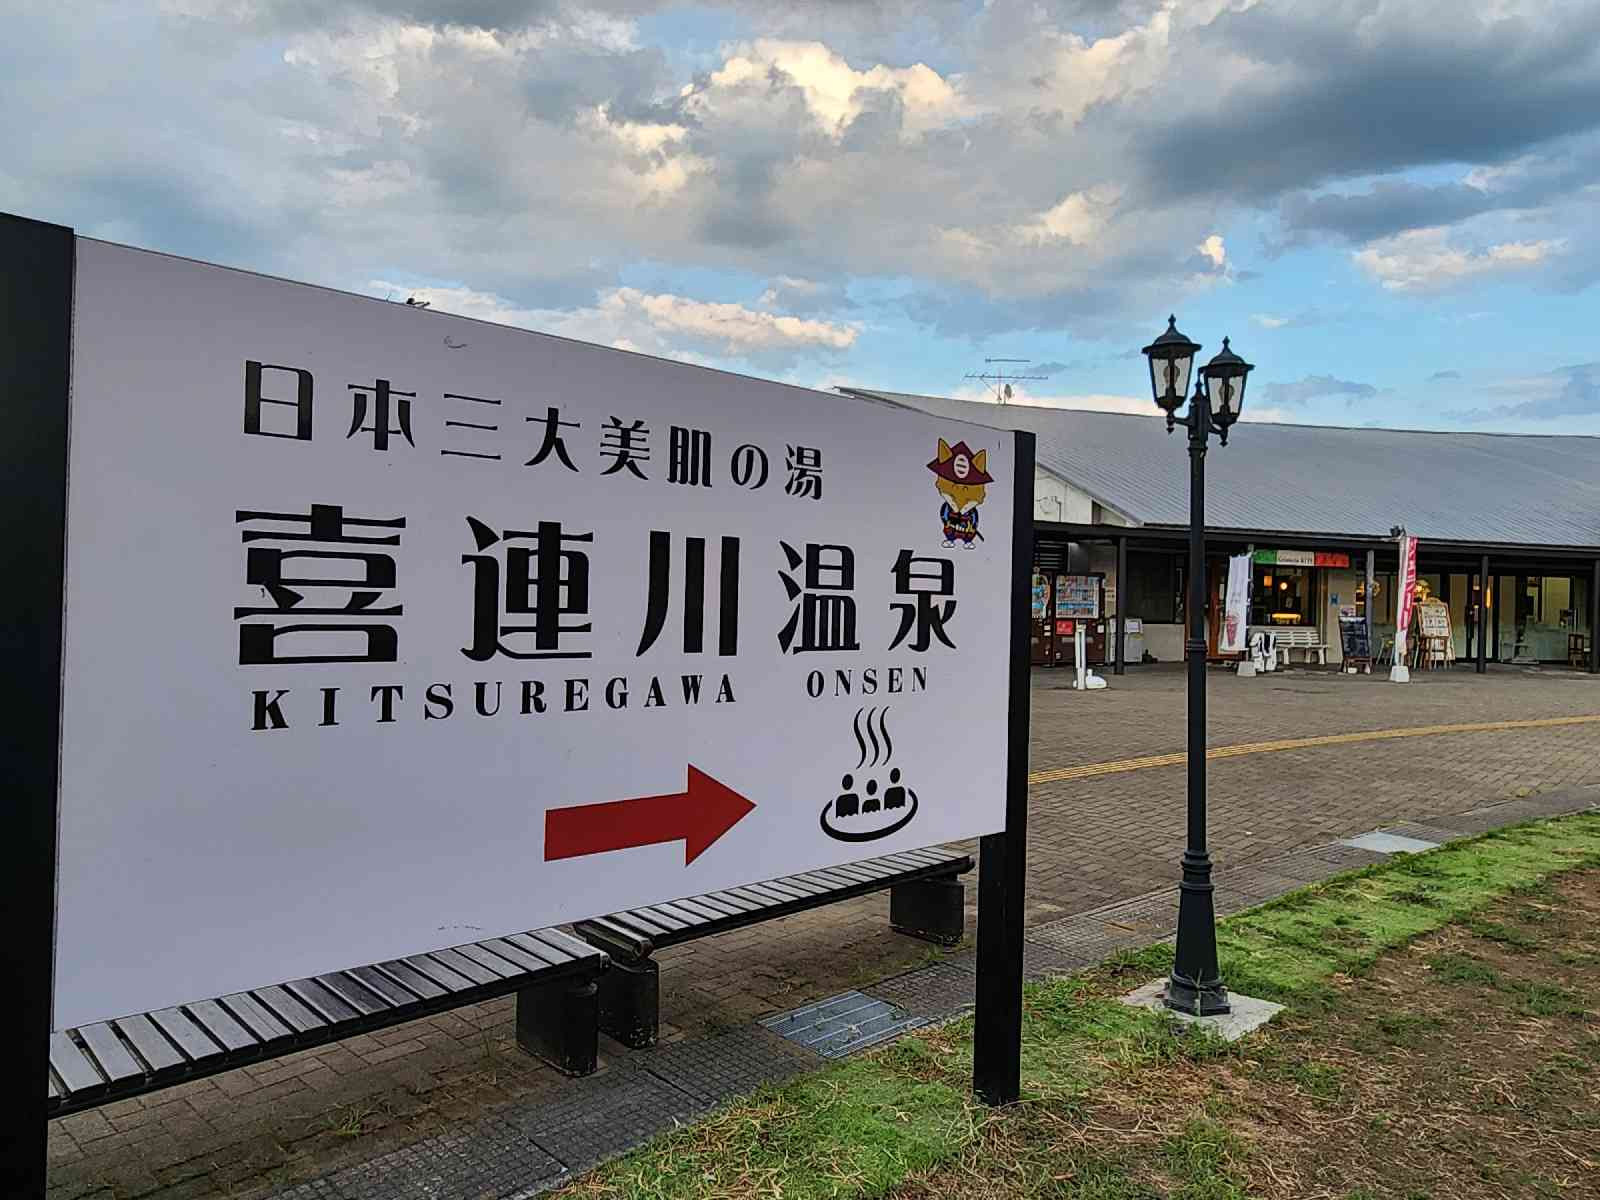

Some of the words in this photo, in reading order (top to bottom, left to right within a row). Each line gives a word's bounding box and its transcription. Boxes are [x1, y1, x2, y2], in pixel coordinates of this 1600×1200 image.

[244, 360, 823, 500] 日本三大美肌の湯
[234, 504, 958, 665] 喜連川温泉
[252, 673, 735, 730] KITSUREGAWA
[807, 667, 928, 698] ONSEN
